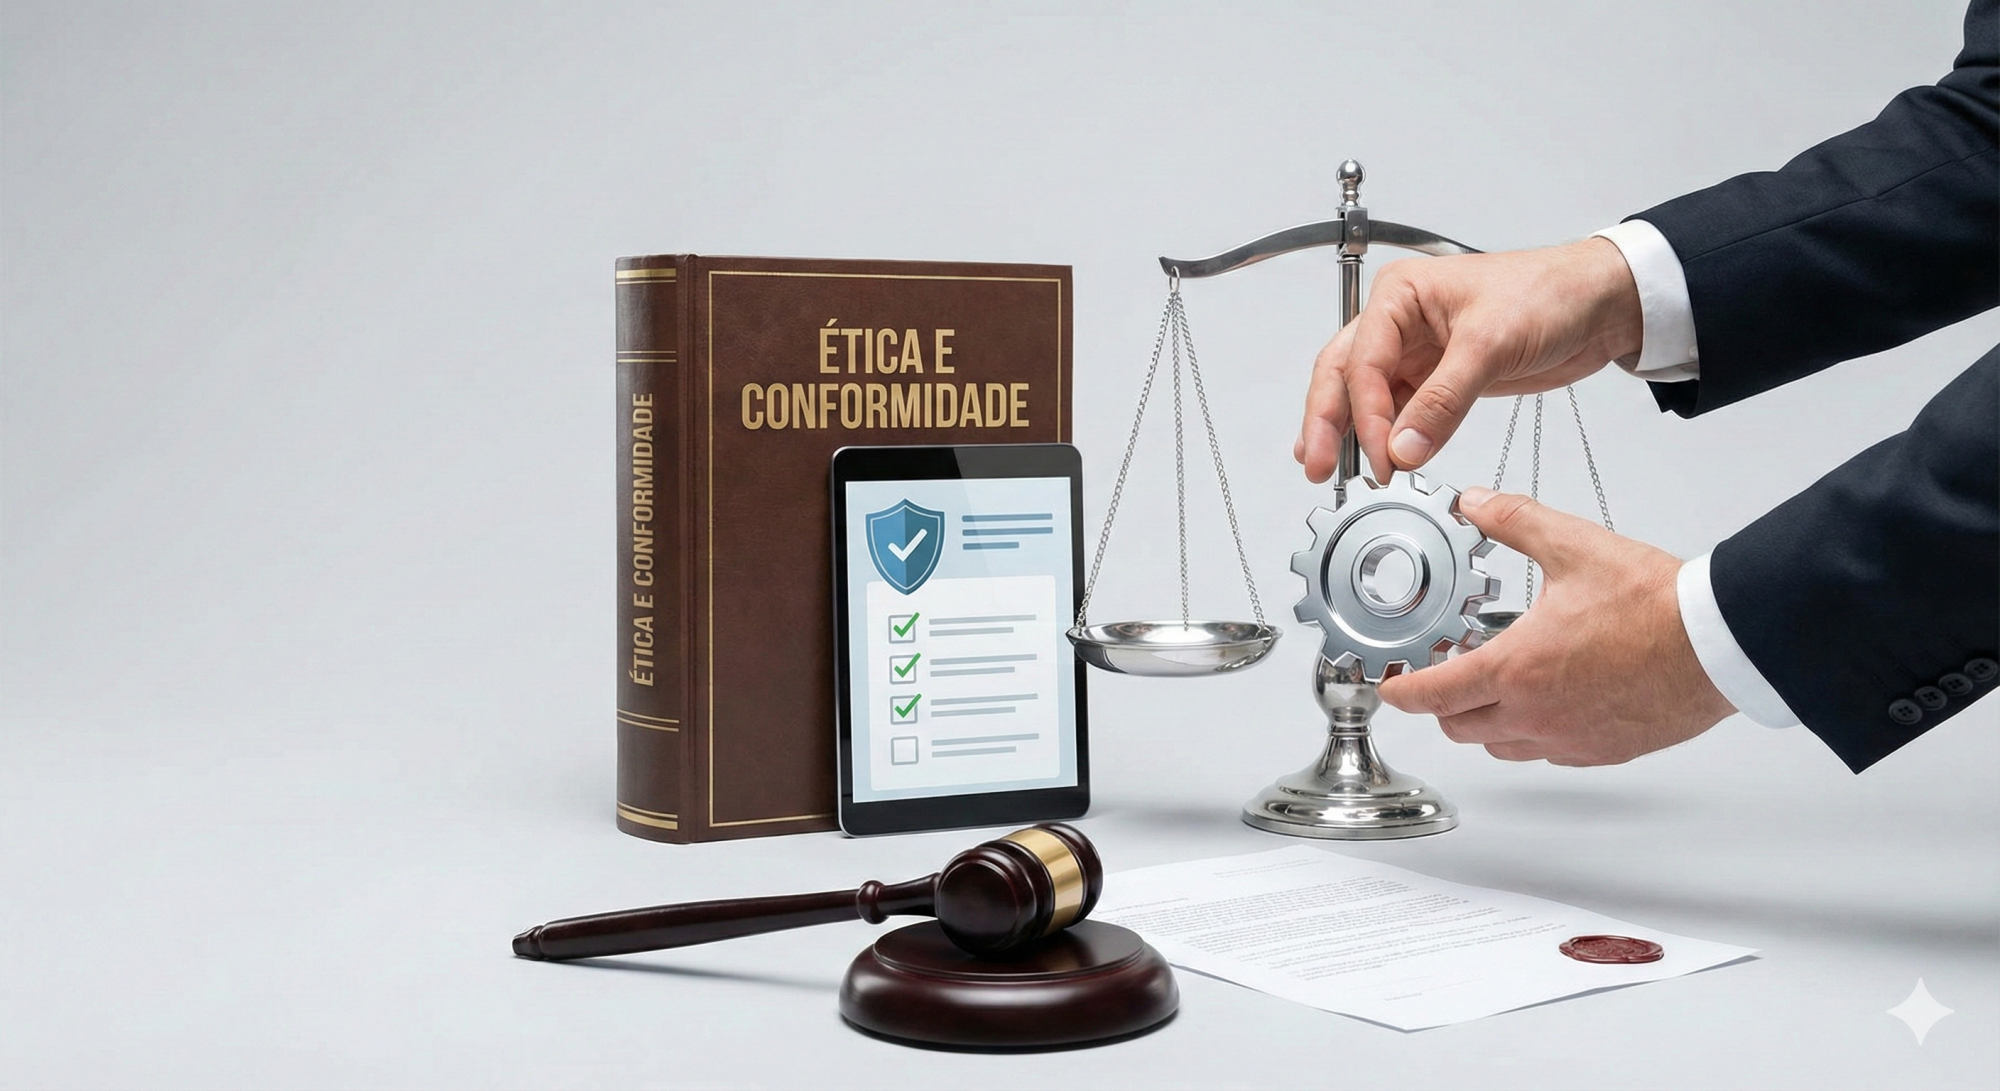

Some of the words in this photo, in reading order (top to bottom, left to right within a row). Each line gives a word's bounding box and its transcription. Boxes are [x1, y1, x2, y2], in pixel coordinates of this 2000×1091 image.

[819, 318, 924, 374] ÉTICA
[935, 328, 955, 374] E
[741, 382, 1030, 430] CONFORMIDADE
[632, 393, 654, 587] CONFORMIDADE
[633, 592, 654, 609] E
[628, 616, 654, 687] ÉTICA
